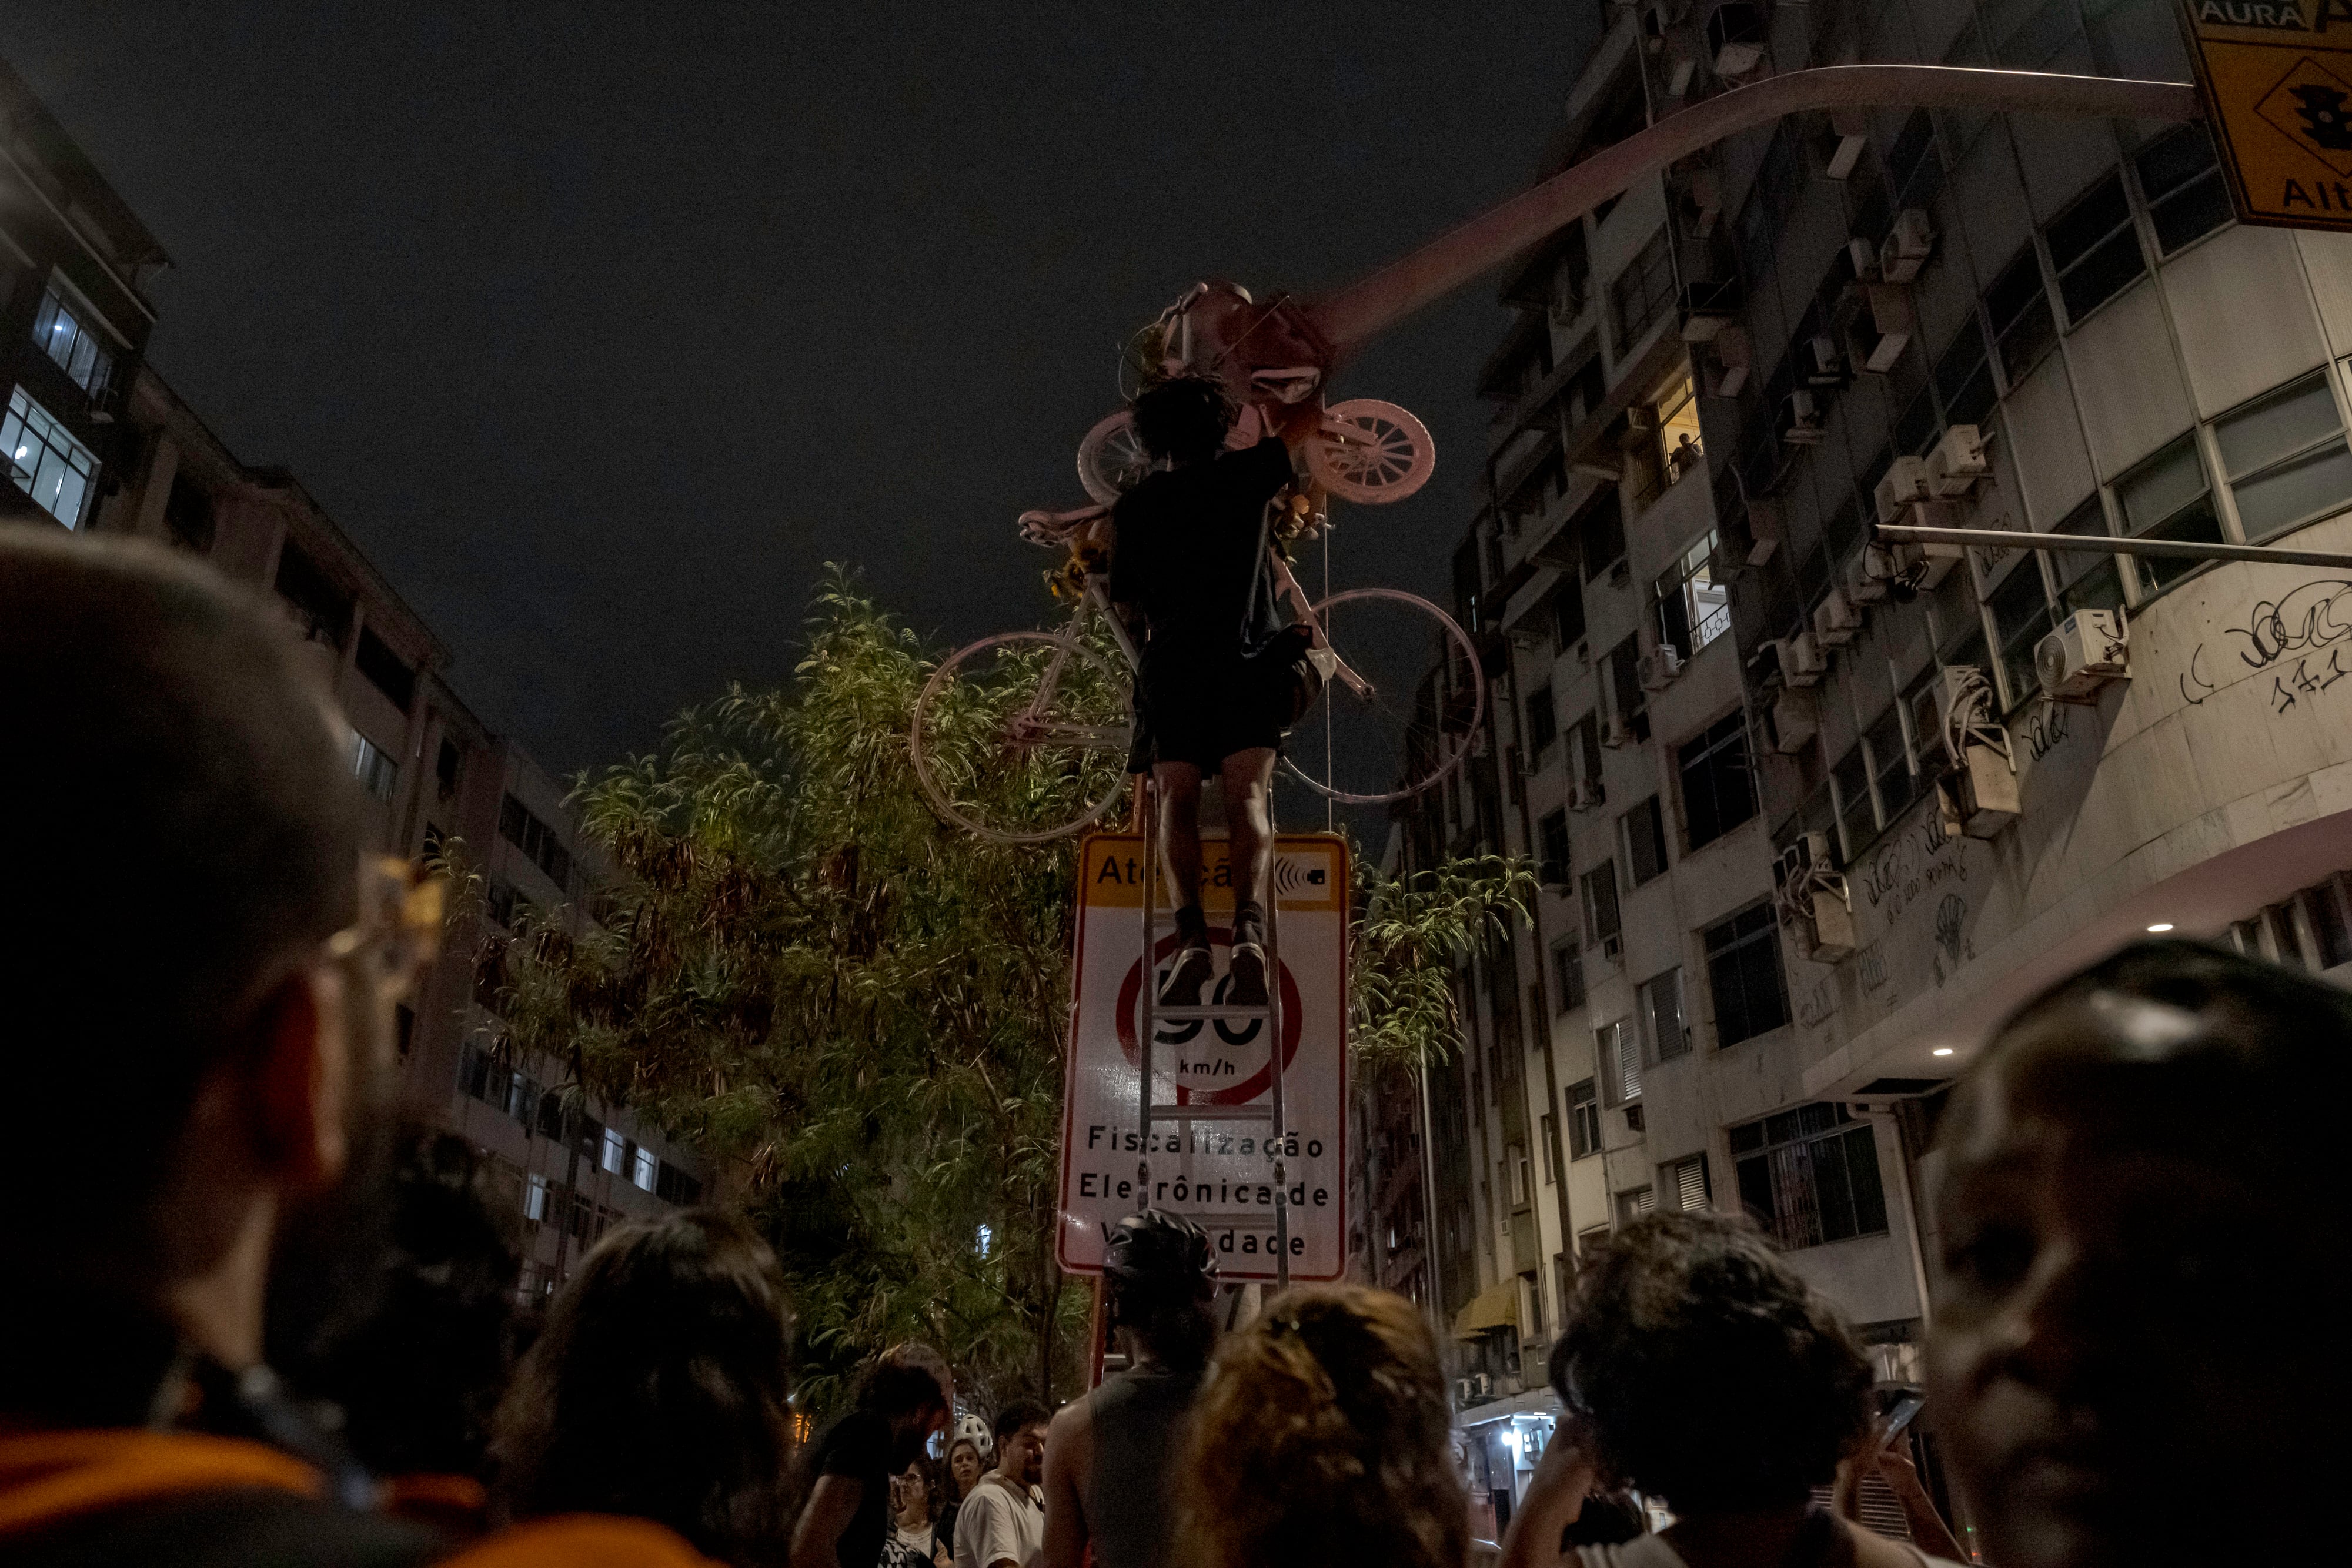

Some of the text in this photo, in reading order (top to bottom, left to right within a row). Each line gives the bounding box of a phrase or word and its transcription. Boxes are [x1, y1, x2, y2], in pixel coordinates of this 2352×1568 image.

[1180, 1059, 1235, 1076] km/h
[1080, 1172, 1328, 1206] Elerônica de
